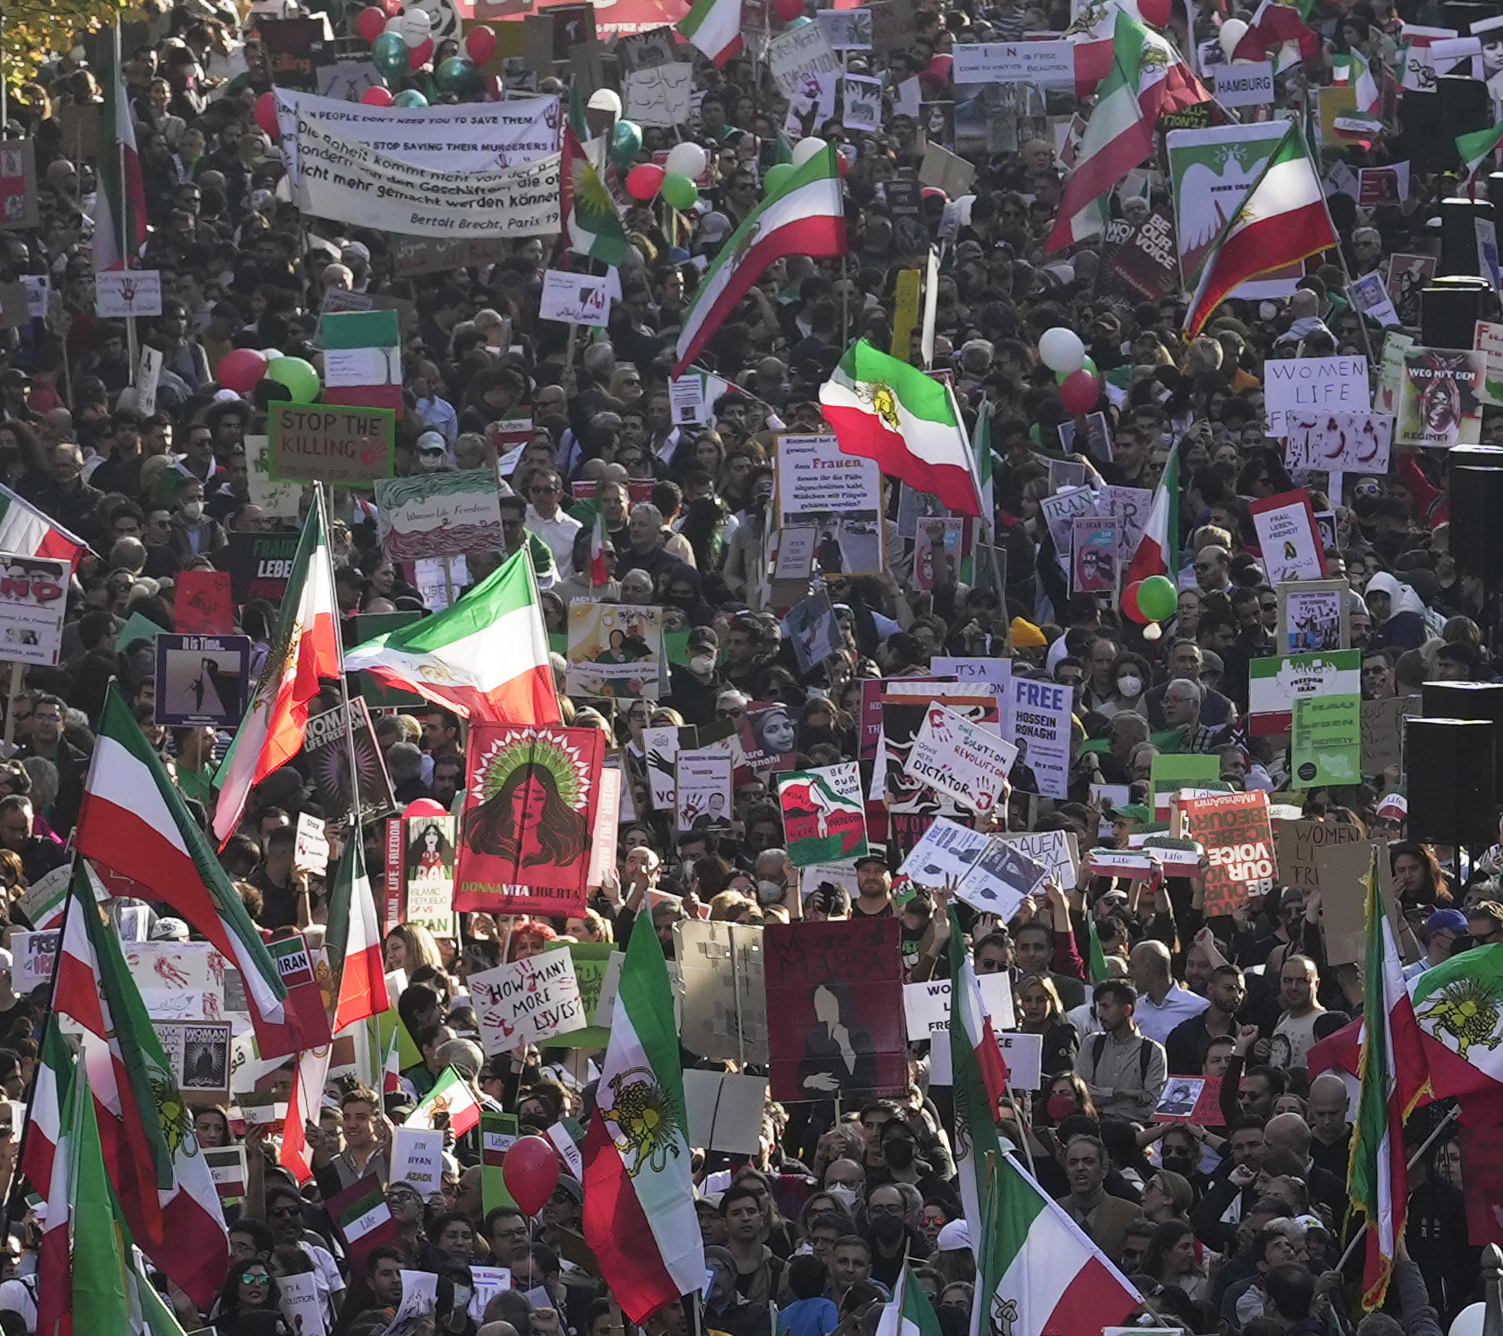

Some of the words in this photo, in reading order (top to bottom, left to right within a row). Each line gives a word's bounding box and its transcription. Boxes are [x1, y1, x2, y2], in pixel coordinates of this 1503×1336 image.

[1218, 76, 1271, 93] HAMBURG
[508, 213, 540, 230] Paris
[1272, 360, 1364, 379] WOMEN
[1296, 384, 1350, 404] LIFE
[281, 410, 336, 432] STOP
[342, 413, 382, 436] THE
[281, 435, 356, 458] KILLING
[0, 577, 65, 602] NO
[1016, 680, 1064, 711] FREE
[1015, 711, 1058, 729] HOSSEIN
[1014, 723, 1058, 741] RONAGHI
[489, 974, 527, 1002] HOW
[531, 958, 568, 988] MANY
[512, 987, 551, 1018] MORE
